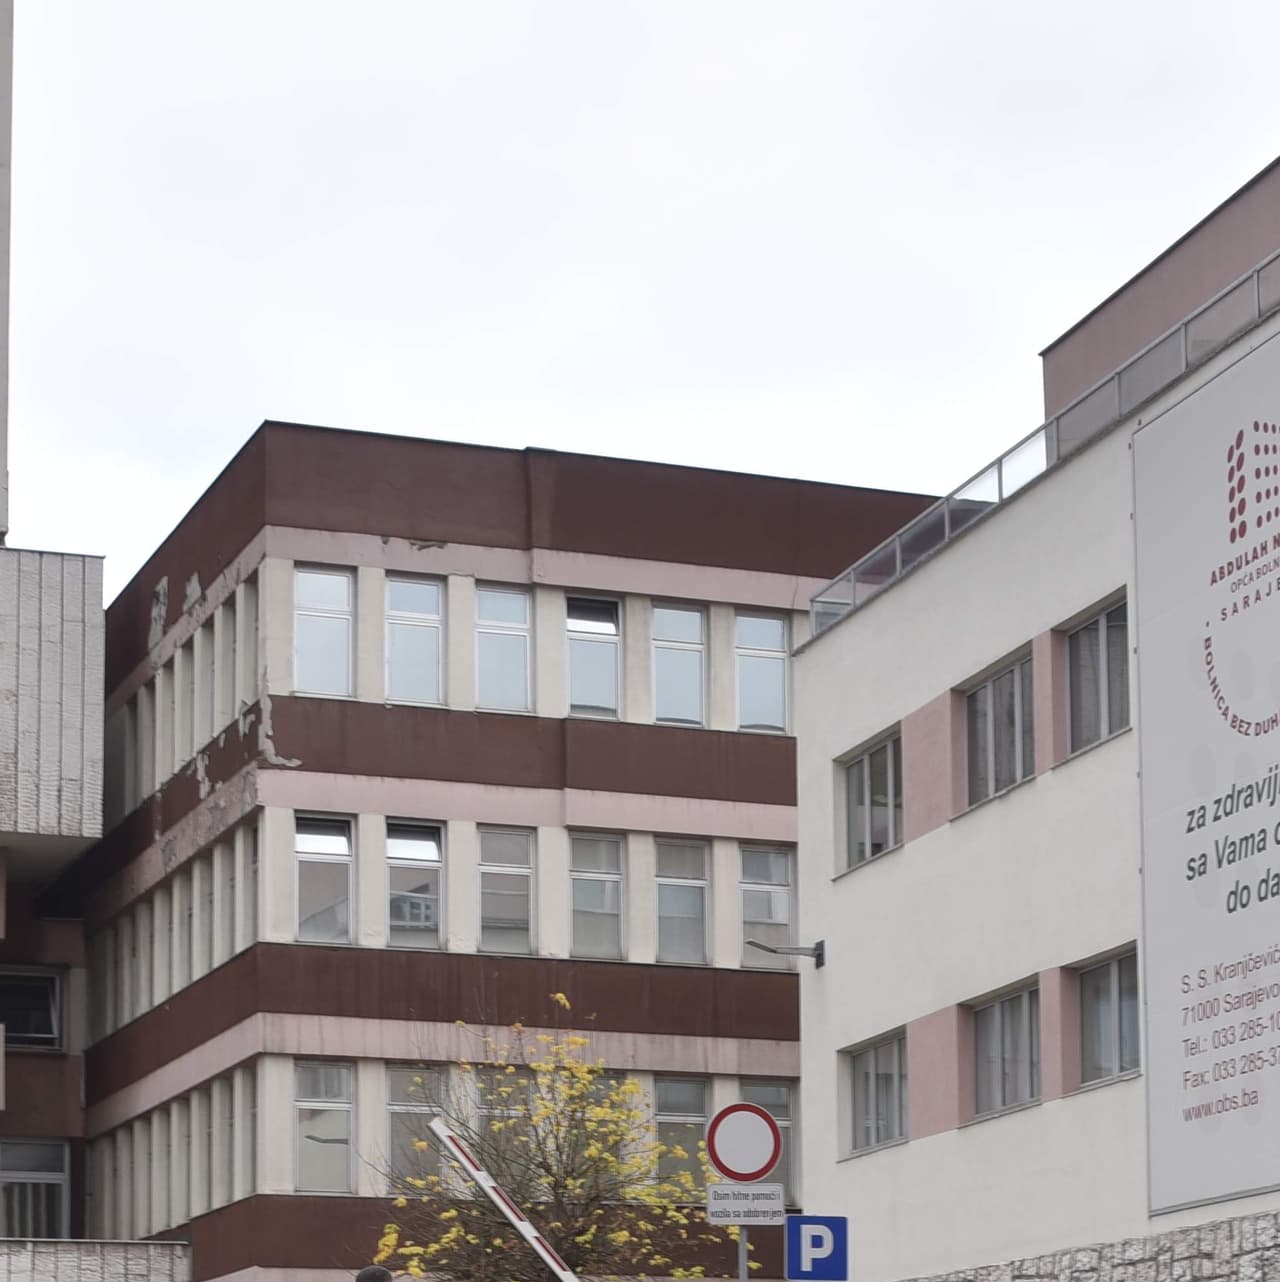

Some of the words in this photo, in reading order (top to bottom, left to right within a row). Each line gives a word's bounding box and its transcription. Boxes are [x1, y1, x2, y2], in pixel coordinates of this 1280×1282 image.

[1210, 541, 1268, 586] ABDULAH
[1204, 636, 1230, 721] BOLNICA
[1230, 713, 1252, 736] BEZ
[1185, 805, 1206, 834] za
[1186, 852, 1207, 881] sa
[1214, 828, 1267, 869] Vama
[1227, 879, 1251, 914] do
[1181, 975, 1194, 994] S.
[1198, 969, 1210, 988] S.
[1182, 998, 1219, 1026] 71000
[1223, 983, 1280, 1013] Sarajevo
[1212, 1026, 1236, 1050] 033
[1213, 1058, 1237, 1082] 033
[1183, 1088, 1259, 1122] www.obs.ba
[800, 1224, 834, 1271] P
